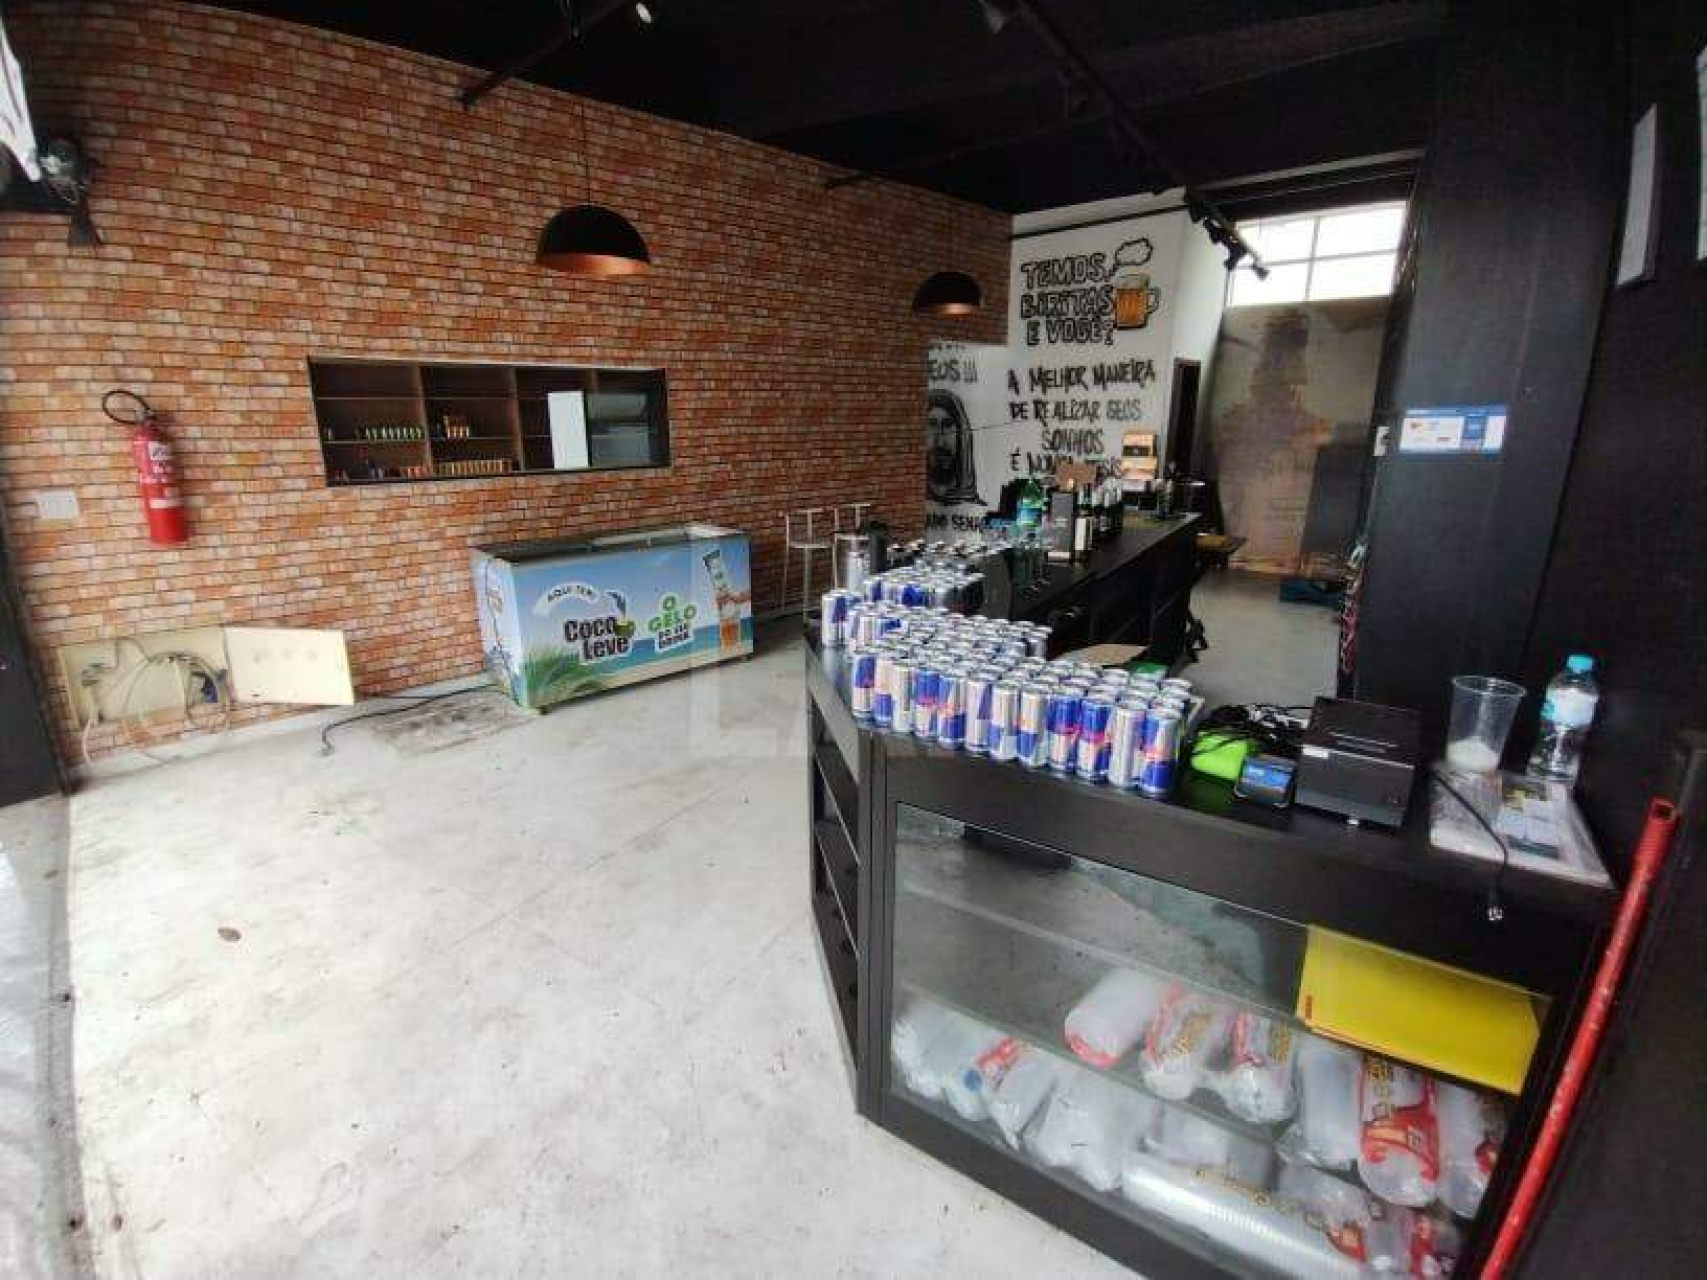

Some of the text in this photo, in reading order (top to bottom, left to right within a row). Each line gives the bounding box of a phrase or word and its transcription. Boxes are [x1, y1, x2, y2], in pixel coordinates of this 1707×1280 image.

[1027, 320, 1040, 345] E
[1008, 359, 1156, 395] A MELHOR MANEIRA
[1010, 401, 1029, 420] DE
[1041, 428, 1105, 456] SONHOS
[662, 596, 676, 611] O
[648, 603, 697, 632] GELO
